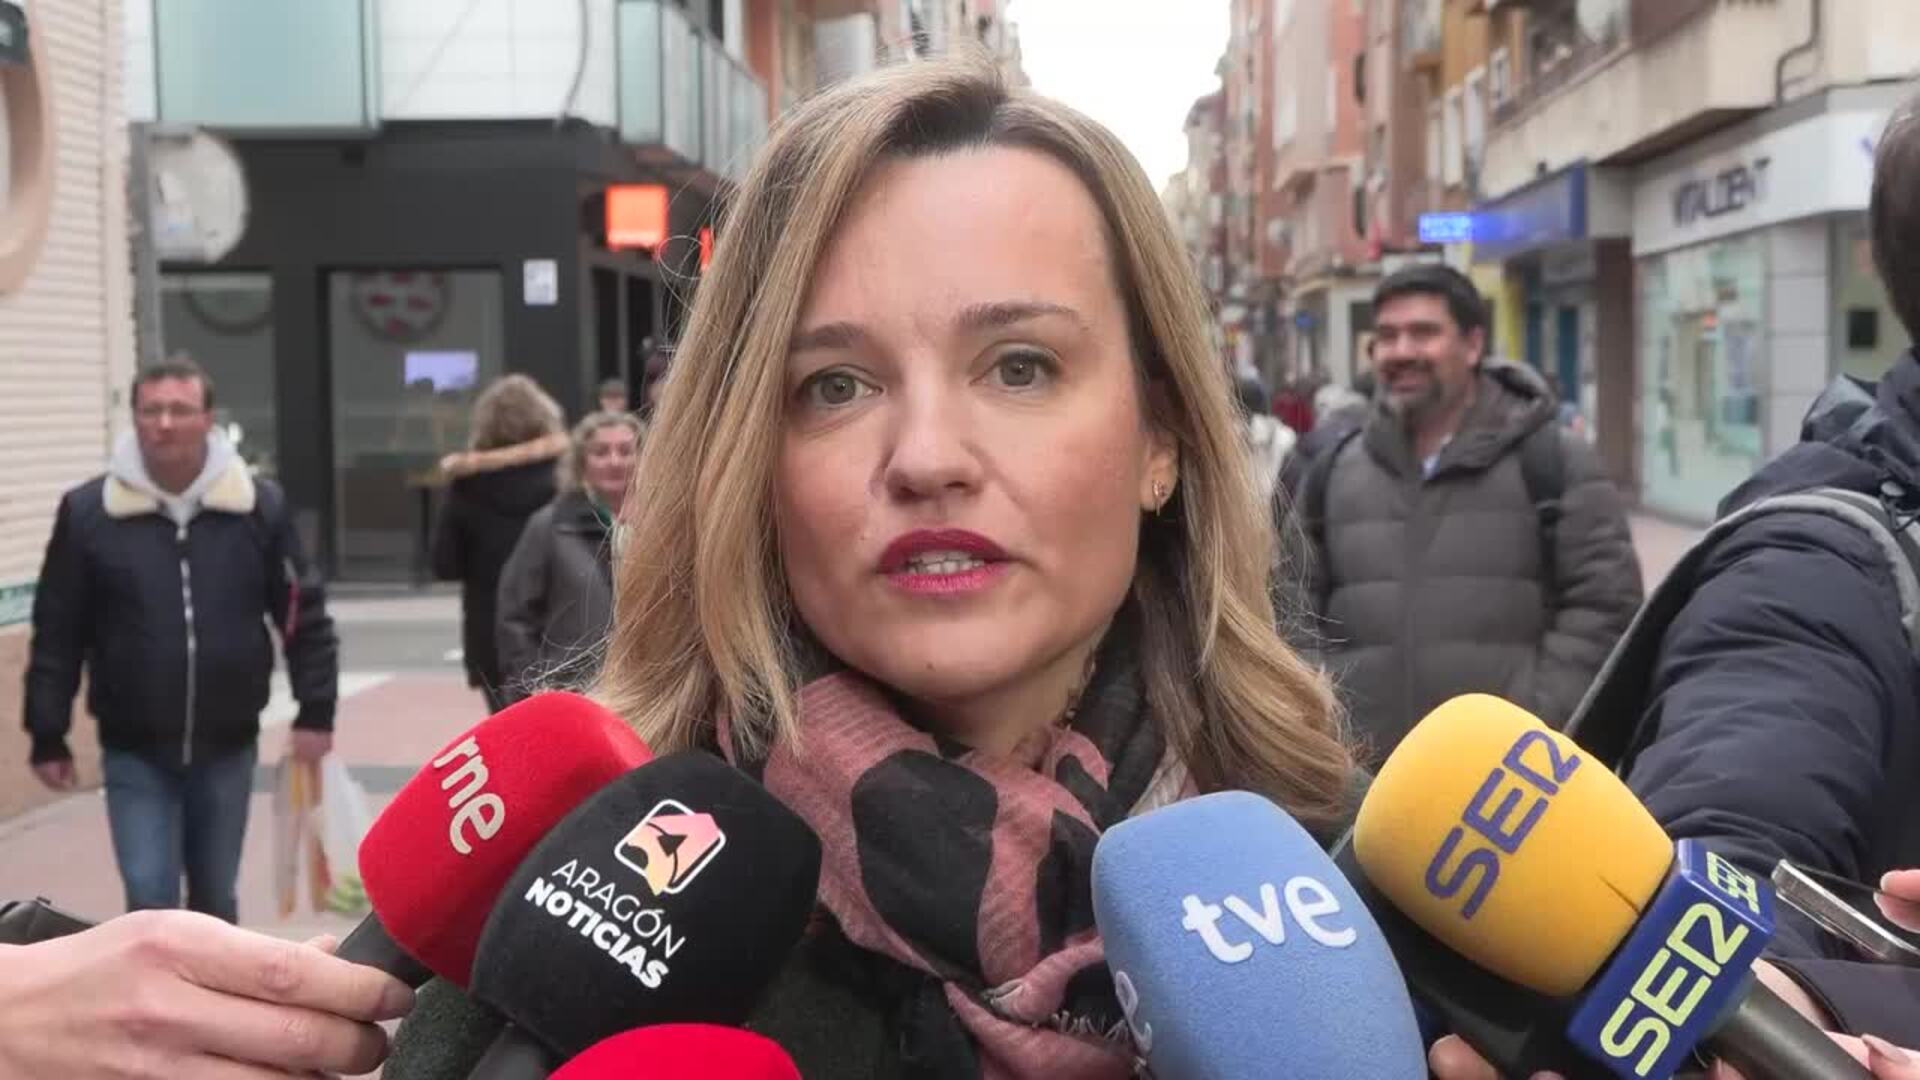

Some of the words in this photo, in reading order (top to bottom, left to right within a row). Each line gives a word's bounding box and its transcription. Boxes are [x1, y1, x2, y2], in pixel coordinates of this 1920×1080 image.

[433, 736, 505, 855] rne
[1424, 729, 1582, 920] SER
[525, 877, 669, 989] NOTICIAS
[552, 858, 686, 959] ARAGÓN
[1181, 876, 1358, 964] tve
[1600, 902, 1749, 1078] SER
